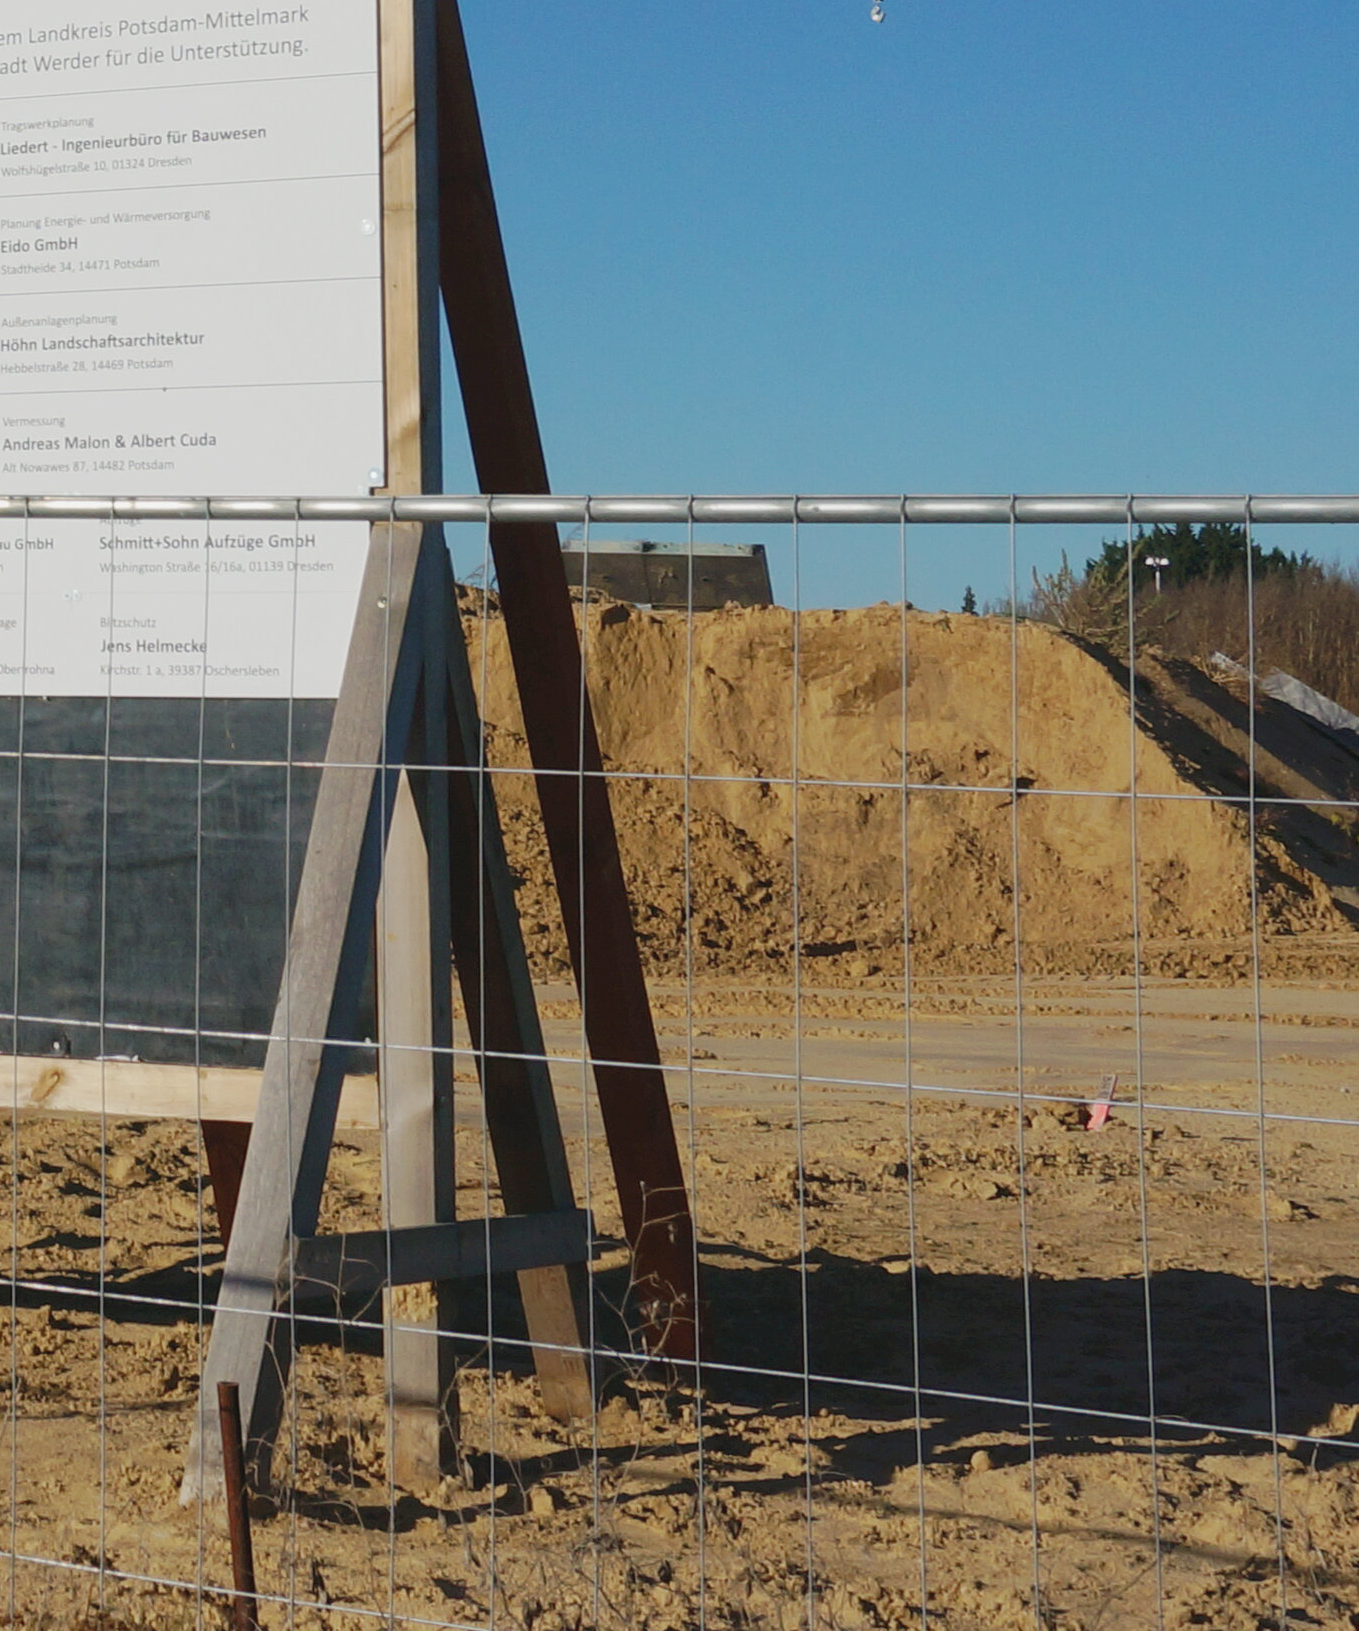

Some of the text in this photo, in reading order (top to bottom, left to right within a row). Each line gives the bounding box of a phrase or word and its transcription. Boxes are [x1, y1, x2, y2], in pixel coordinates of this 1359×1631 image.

[29, 21, 112, 44] Landkreis
[119, 5, 309, 36] Potsdam-Mittelmark
[33, 52, 100, 72] Werder
[106, 49, 132, 67] für
[137, 47, 164, 64] die
[171, 40, 308, 62] Unterstützung.
[0, 141, 48, 155] Liedert
[62, 133, 162, 154] Ingenieurbüro
[166, 131, 187, 144] für
[192, 128, 266, 143] Bauwesen
[1, 237, 78, 253] Eido GmbH
[1, 332, 204, 352] Höhn Landschaftsarchitektur
[2, 437, 60, 451] Andreas
[115, 435, 126, 448] &
[130, 434, 175, 448] Albert
[180, 432, 216, 447] Cuda
[14, 538, 54, 551] GmbH
[100, 535, 199, 551] Schmitt+Sohn
[204, 534, 264, 551] Aufzüge
[100, 638, 207, 654] Jens Helmecke
